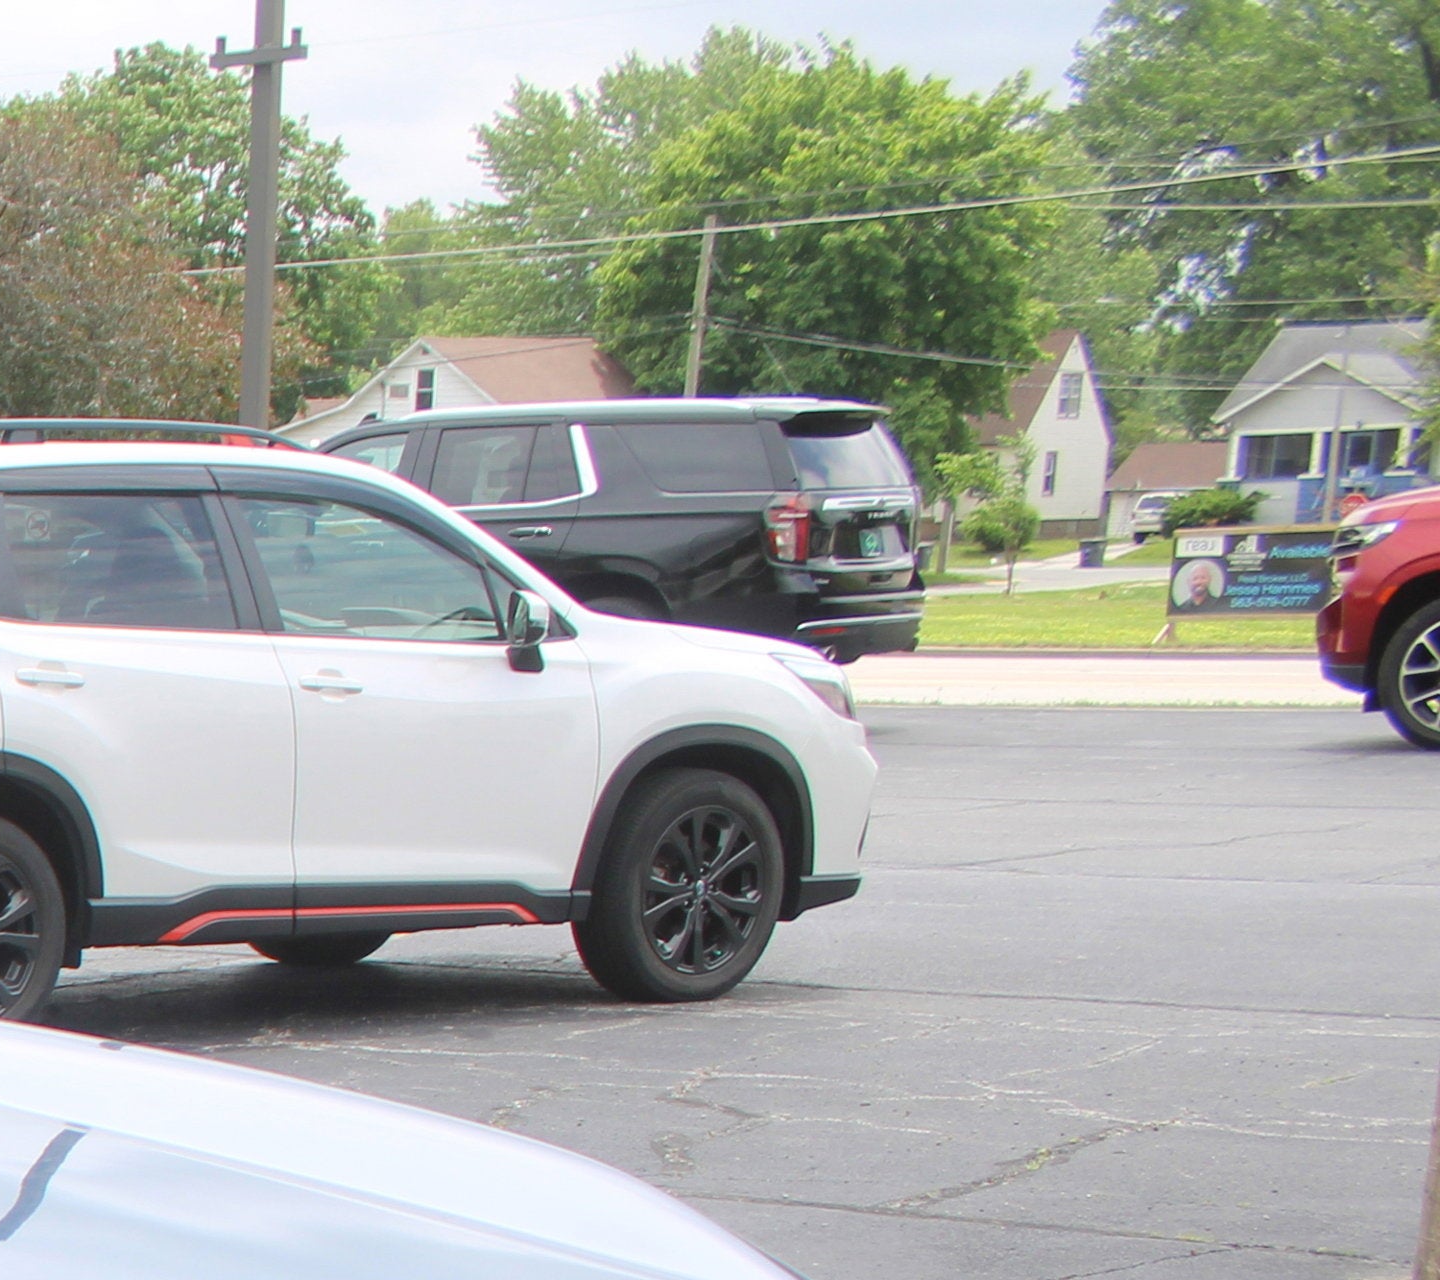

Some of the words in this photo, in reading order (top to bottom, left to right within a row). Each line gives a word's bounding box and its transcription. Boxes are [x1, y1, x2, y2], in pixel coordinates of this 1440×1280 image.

[1268, 544, 1331, 559] Available
[1225, 585, 1260, 596] Jesse
[1263, 583, 1321, 595] Hammes
